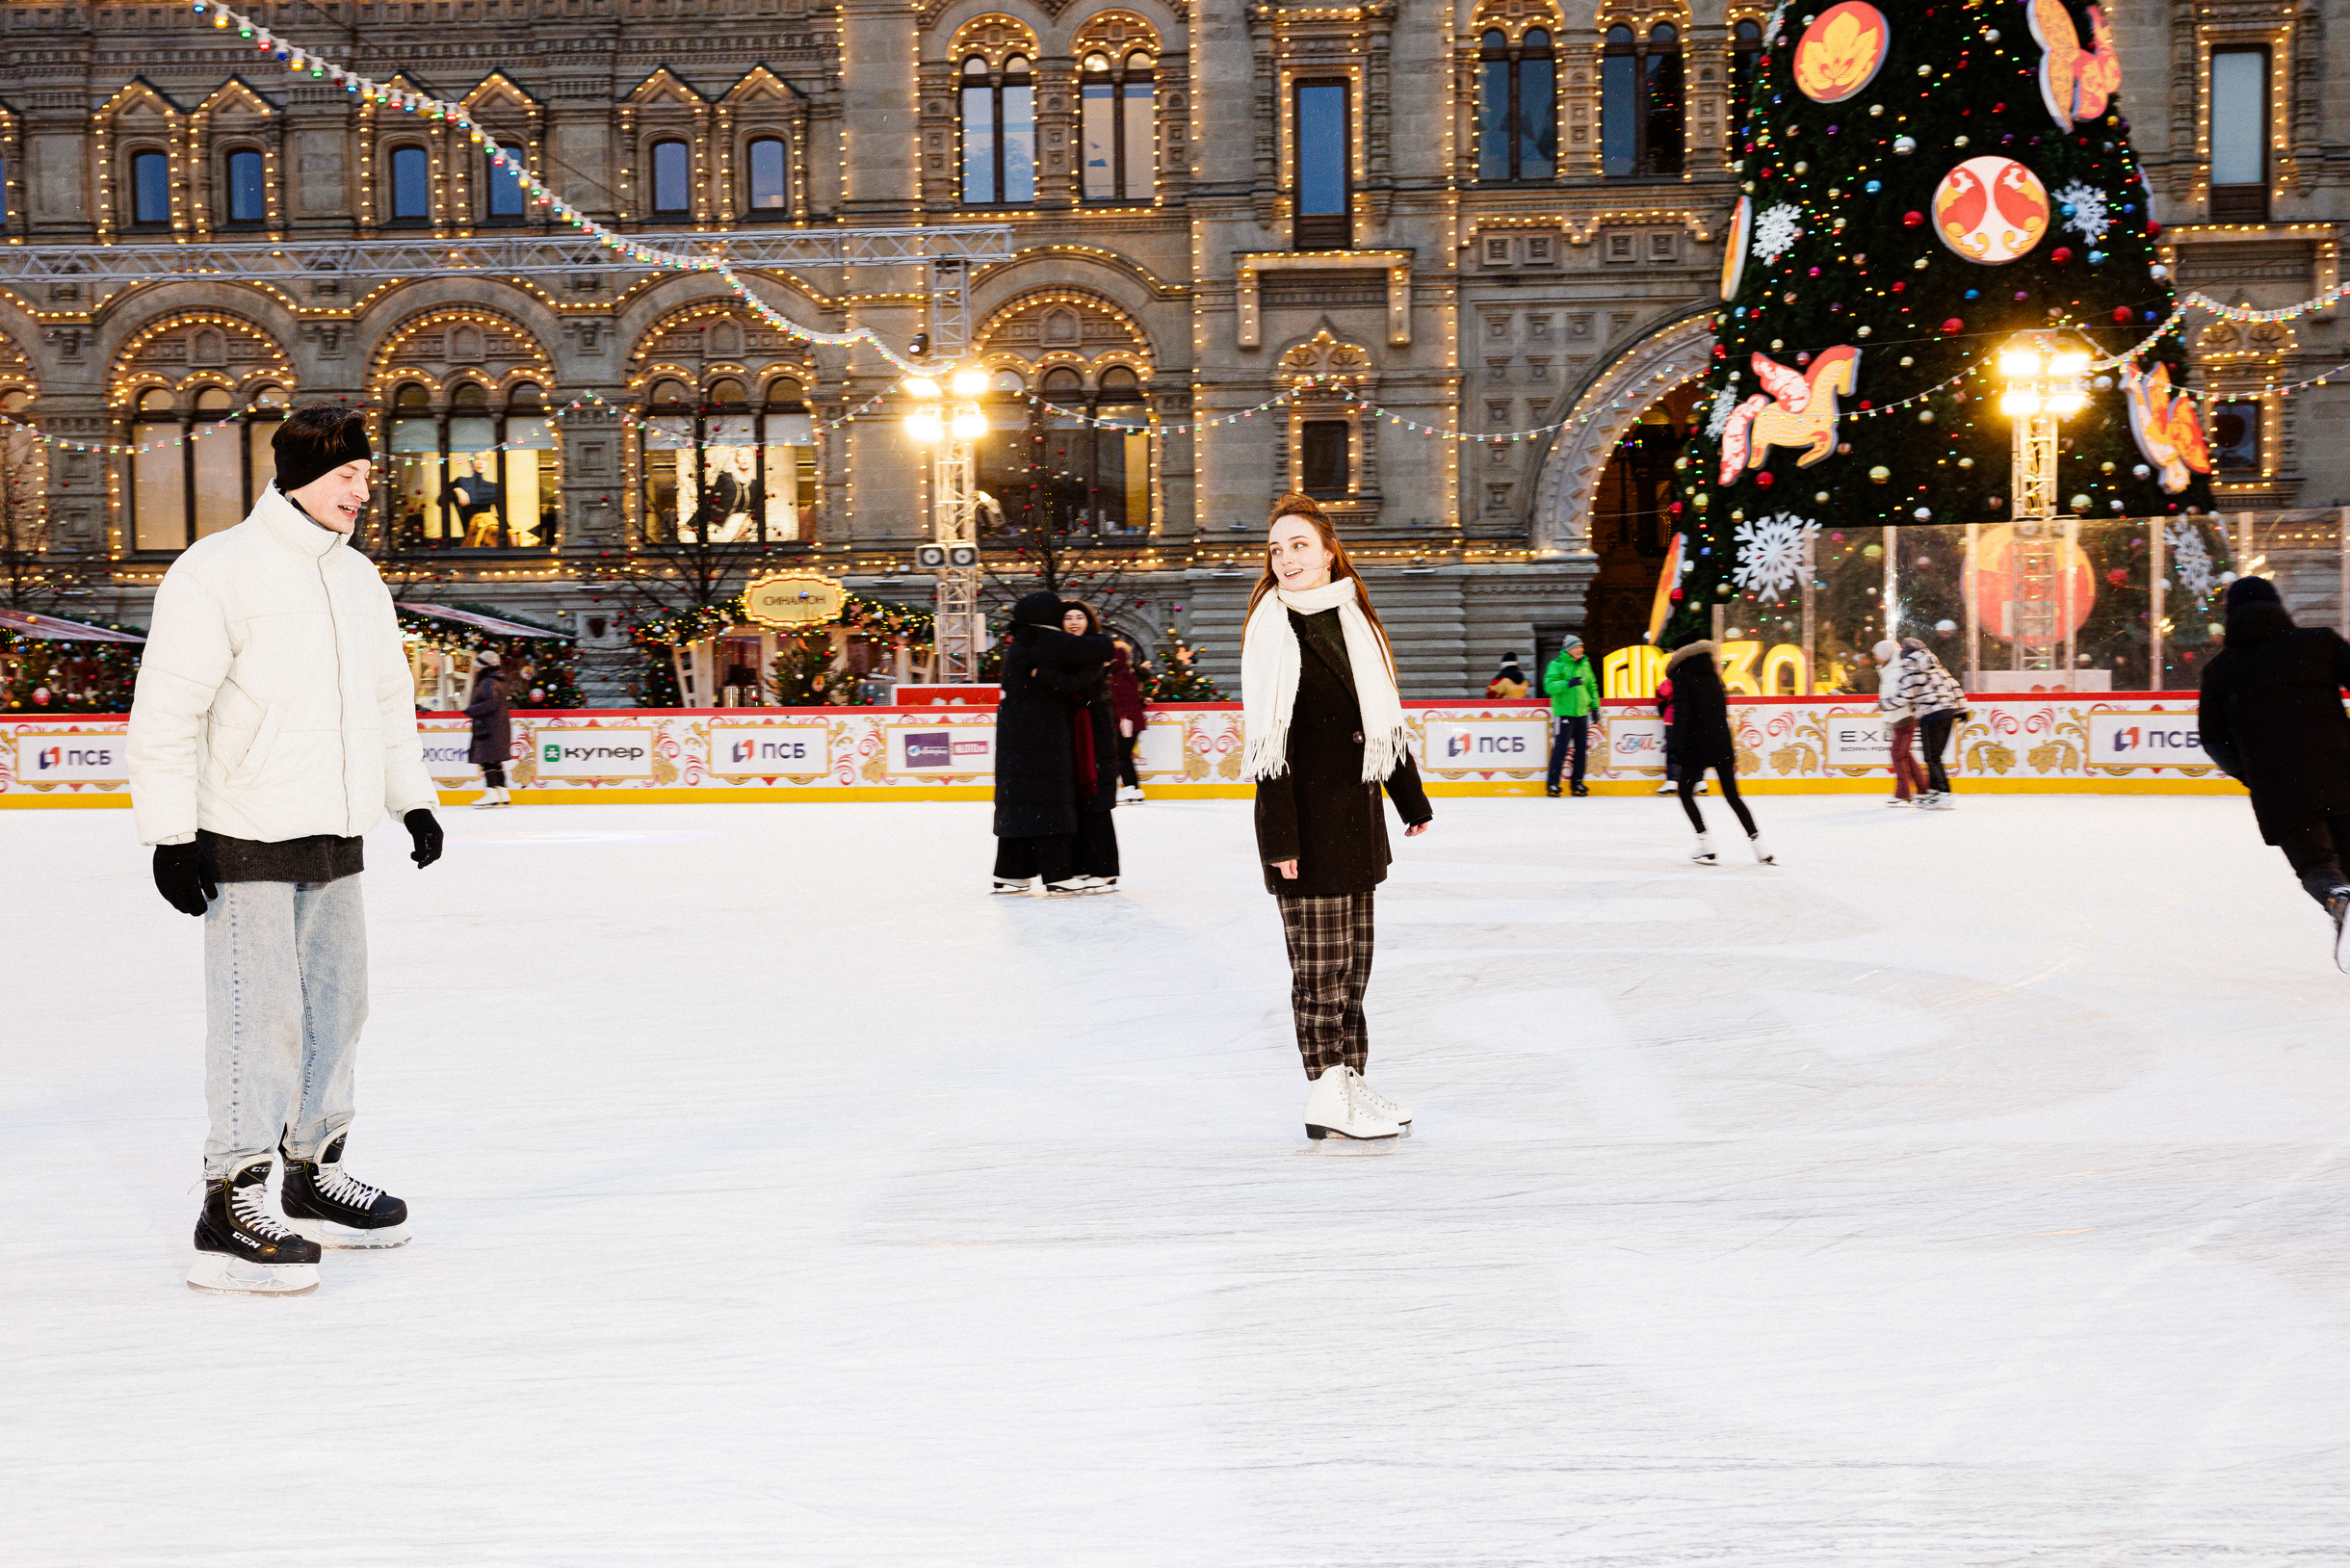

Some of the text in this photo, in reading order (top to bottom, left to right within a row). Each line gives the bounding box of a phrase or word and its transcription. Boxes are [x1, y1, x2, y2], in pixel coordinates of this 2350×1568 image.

[1478, 736, 1525, 753] ПСБ
[2149, 730, 2201, 748] ПСБ
[68, 749, 112, 766] ПСБ
[762, 743, 806, 760] ПСБ
[232, 1230, 261, 1249] CCM
